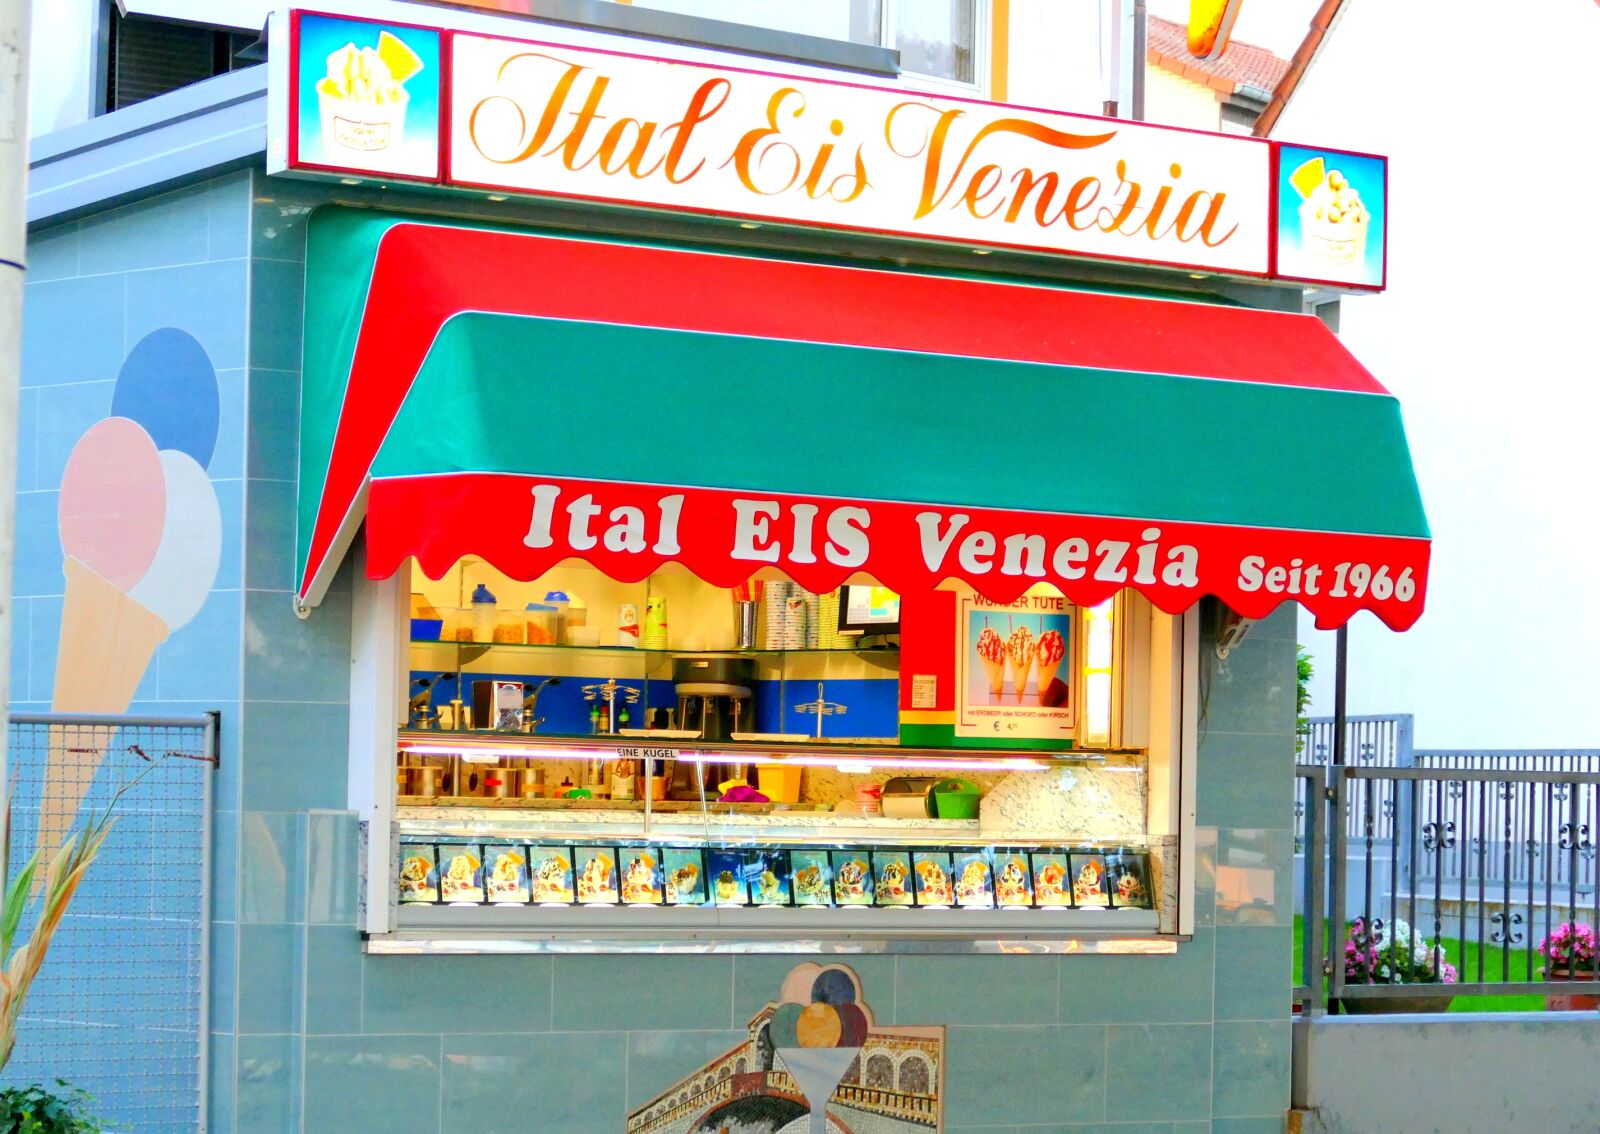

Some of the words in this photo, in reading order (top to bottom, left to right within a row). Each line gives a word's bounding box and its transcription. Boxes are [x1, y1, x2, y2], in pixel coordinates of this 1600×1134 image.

[468, 52, 732, 185] Ital
[718, 87, 875, 203] Eis
[884, 91, 1240, 248] Venezia
[523, 484, 686, 556] Ital
[730, 499, 871, 568] EIS
[915, 511, 1199, 588] Venezia
[1237, 555, 1323, 596] Seit
[1328, 562, 1416, 602] 1966
[616, 748, 639, 757] EINE
[643, 748, 676, 758] KUGEL
